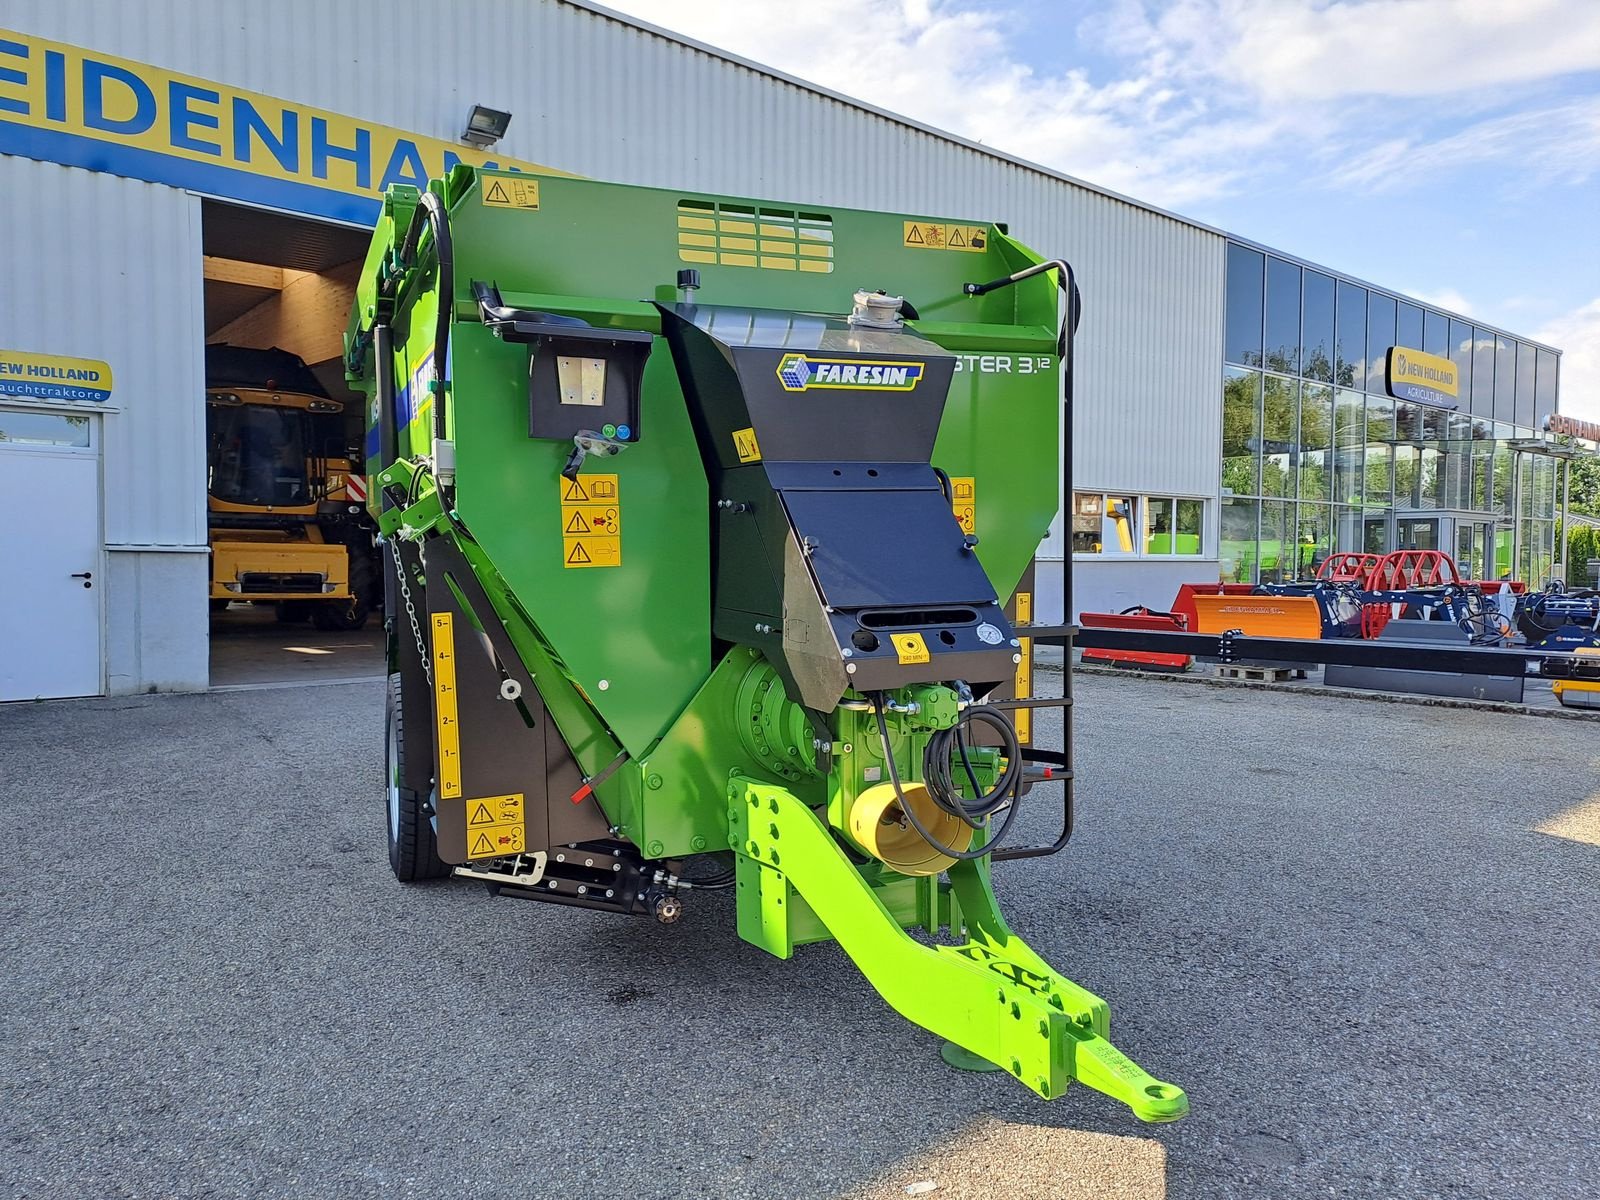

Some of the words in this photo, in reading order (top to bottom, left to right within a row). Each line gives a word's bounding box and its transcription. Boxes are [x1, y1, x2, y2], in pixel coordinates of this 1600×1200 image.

[27, 365, 99, 381] HOLLAND
[815, 365, 907, 385] FARESIN
[1408, 362, 1424, 378] NEW
[1424, 367, 1453, 385] HOLLAND
[1407, 387, 1443, 403] AGRICULTURE
[436, 619, 443, 627] 5
[438, 652, 445, 660] 4
[440, 684, 447, 692] 3
[442, 717, 449, 725] 2
[444, 749, 450, 757] 1
[446, 782, 452, 790] 0
